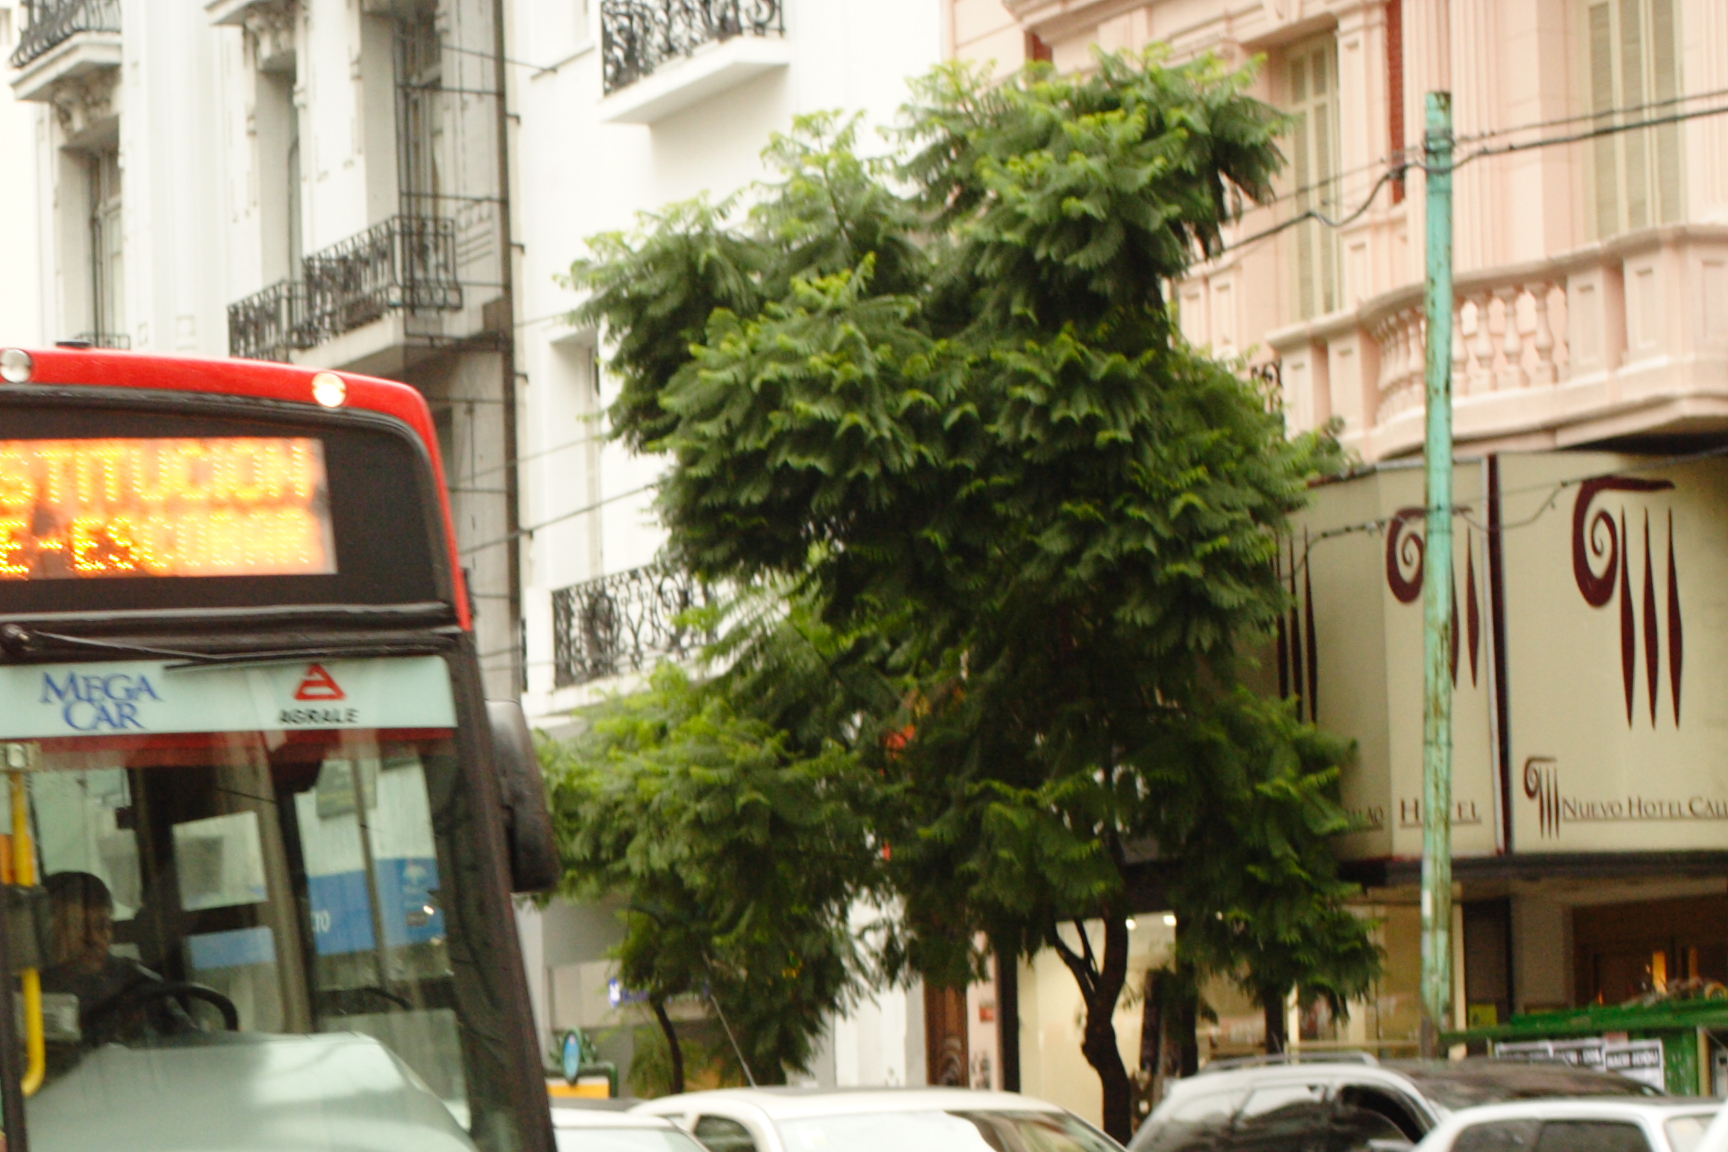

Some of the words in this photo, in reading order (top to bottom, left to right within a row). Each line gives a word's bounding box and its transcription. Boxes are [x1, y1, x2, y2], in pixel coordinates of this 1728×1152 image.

[39, 671, 165, 704] MEGA
[62, 701, 147, 732] CAR
[278, 707, 360, 726] AGRALE
